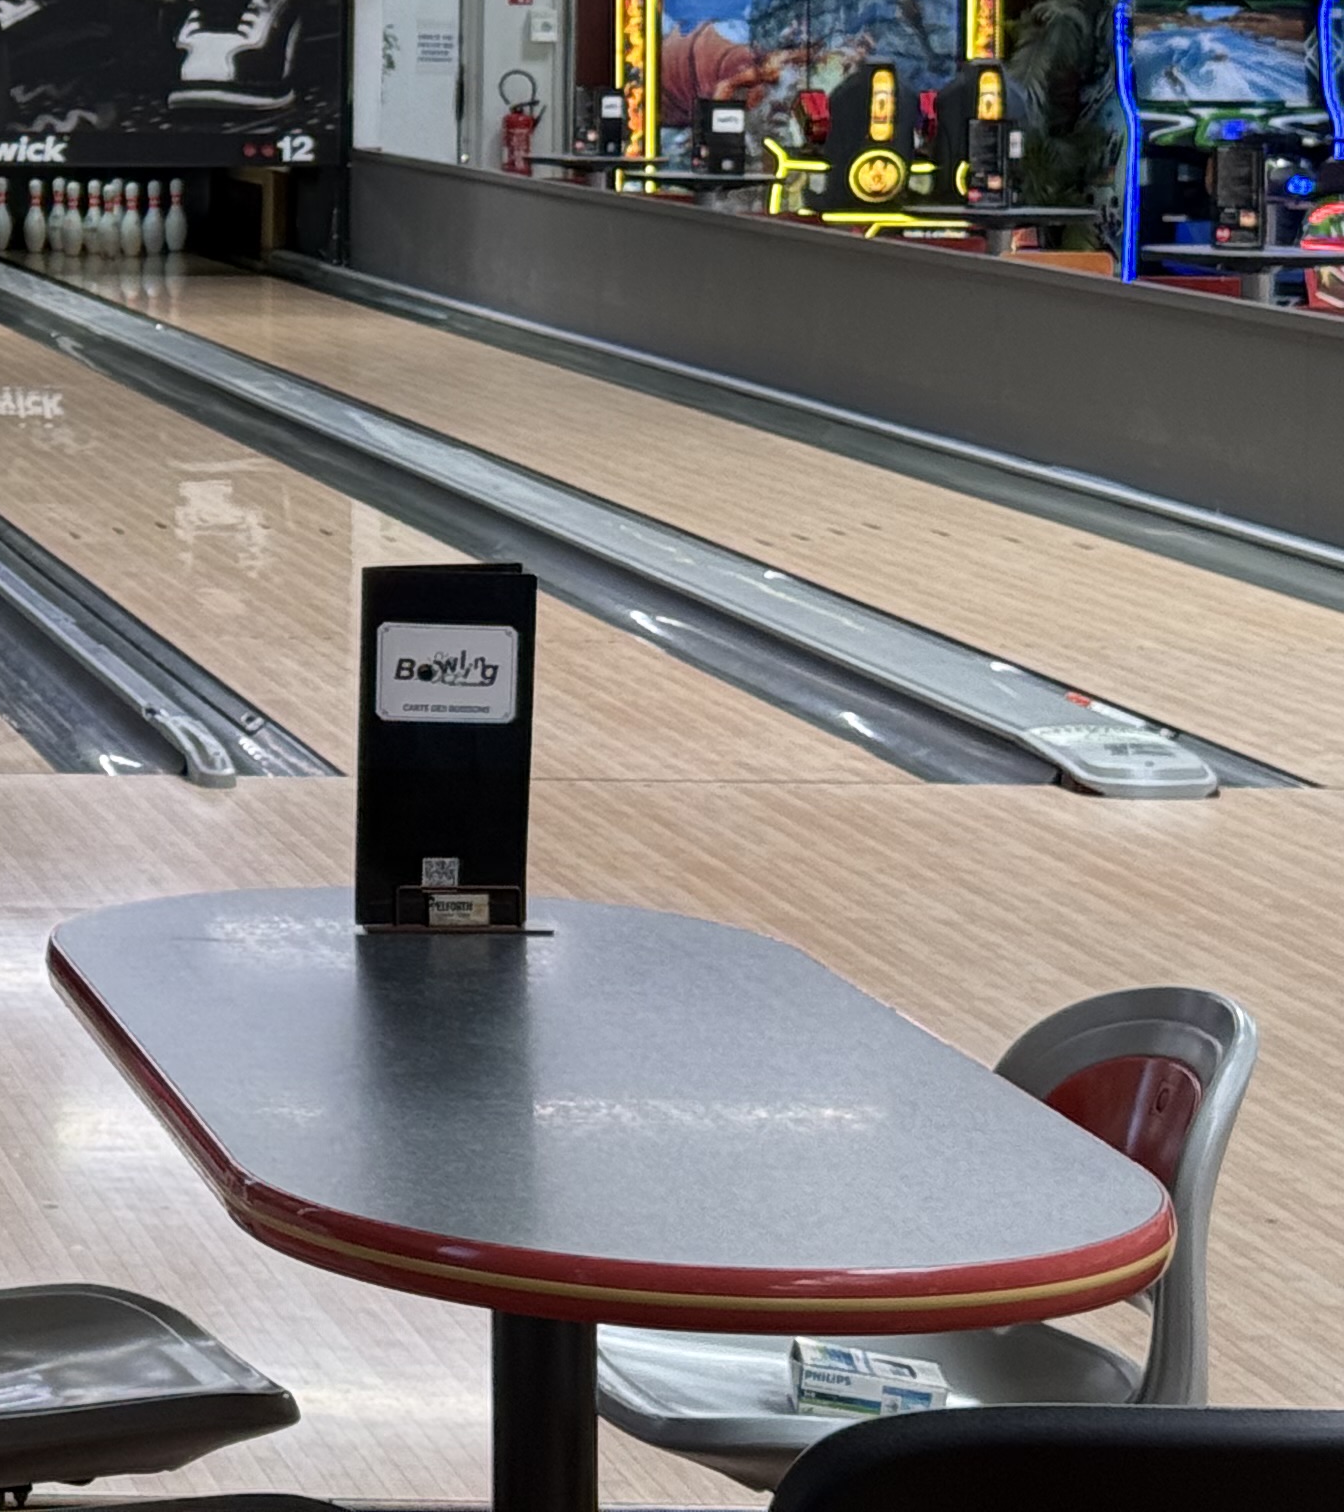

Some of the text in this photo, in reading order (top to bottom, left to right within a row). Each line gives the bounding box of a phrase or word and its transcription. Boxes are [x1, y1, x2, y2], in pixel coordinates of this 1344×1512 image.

[277, 135, 316, 162] 12
[393, 649, 499, 687] Bowling
[804, 1370, 852, 1386] PHILIPS
